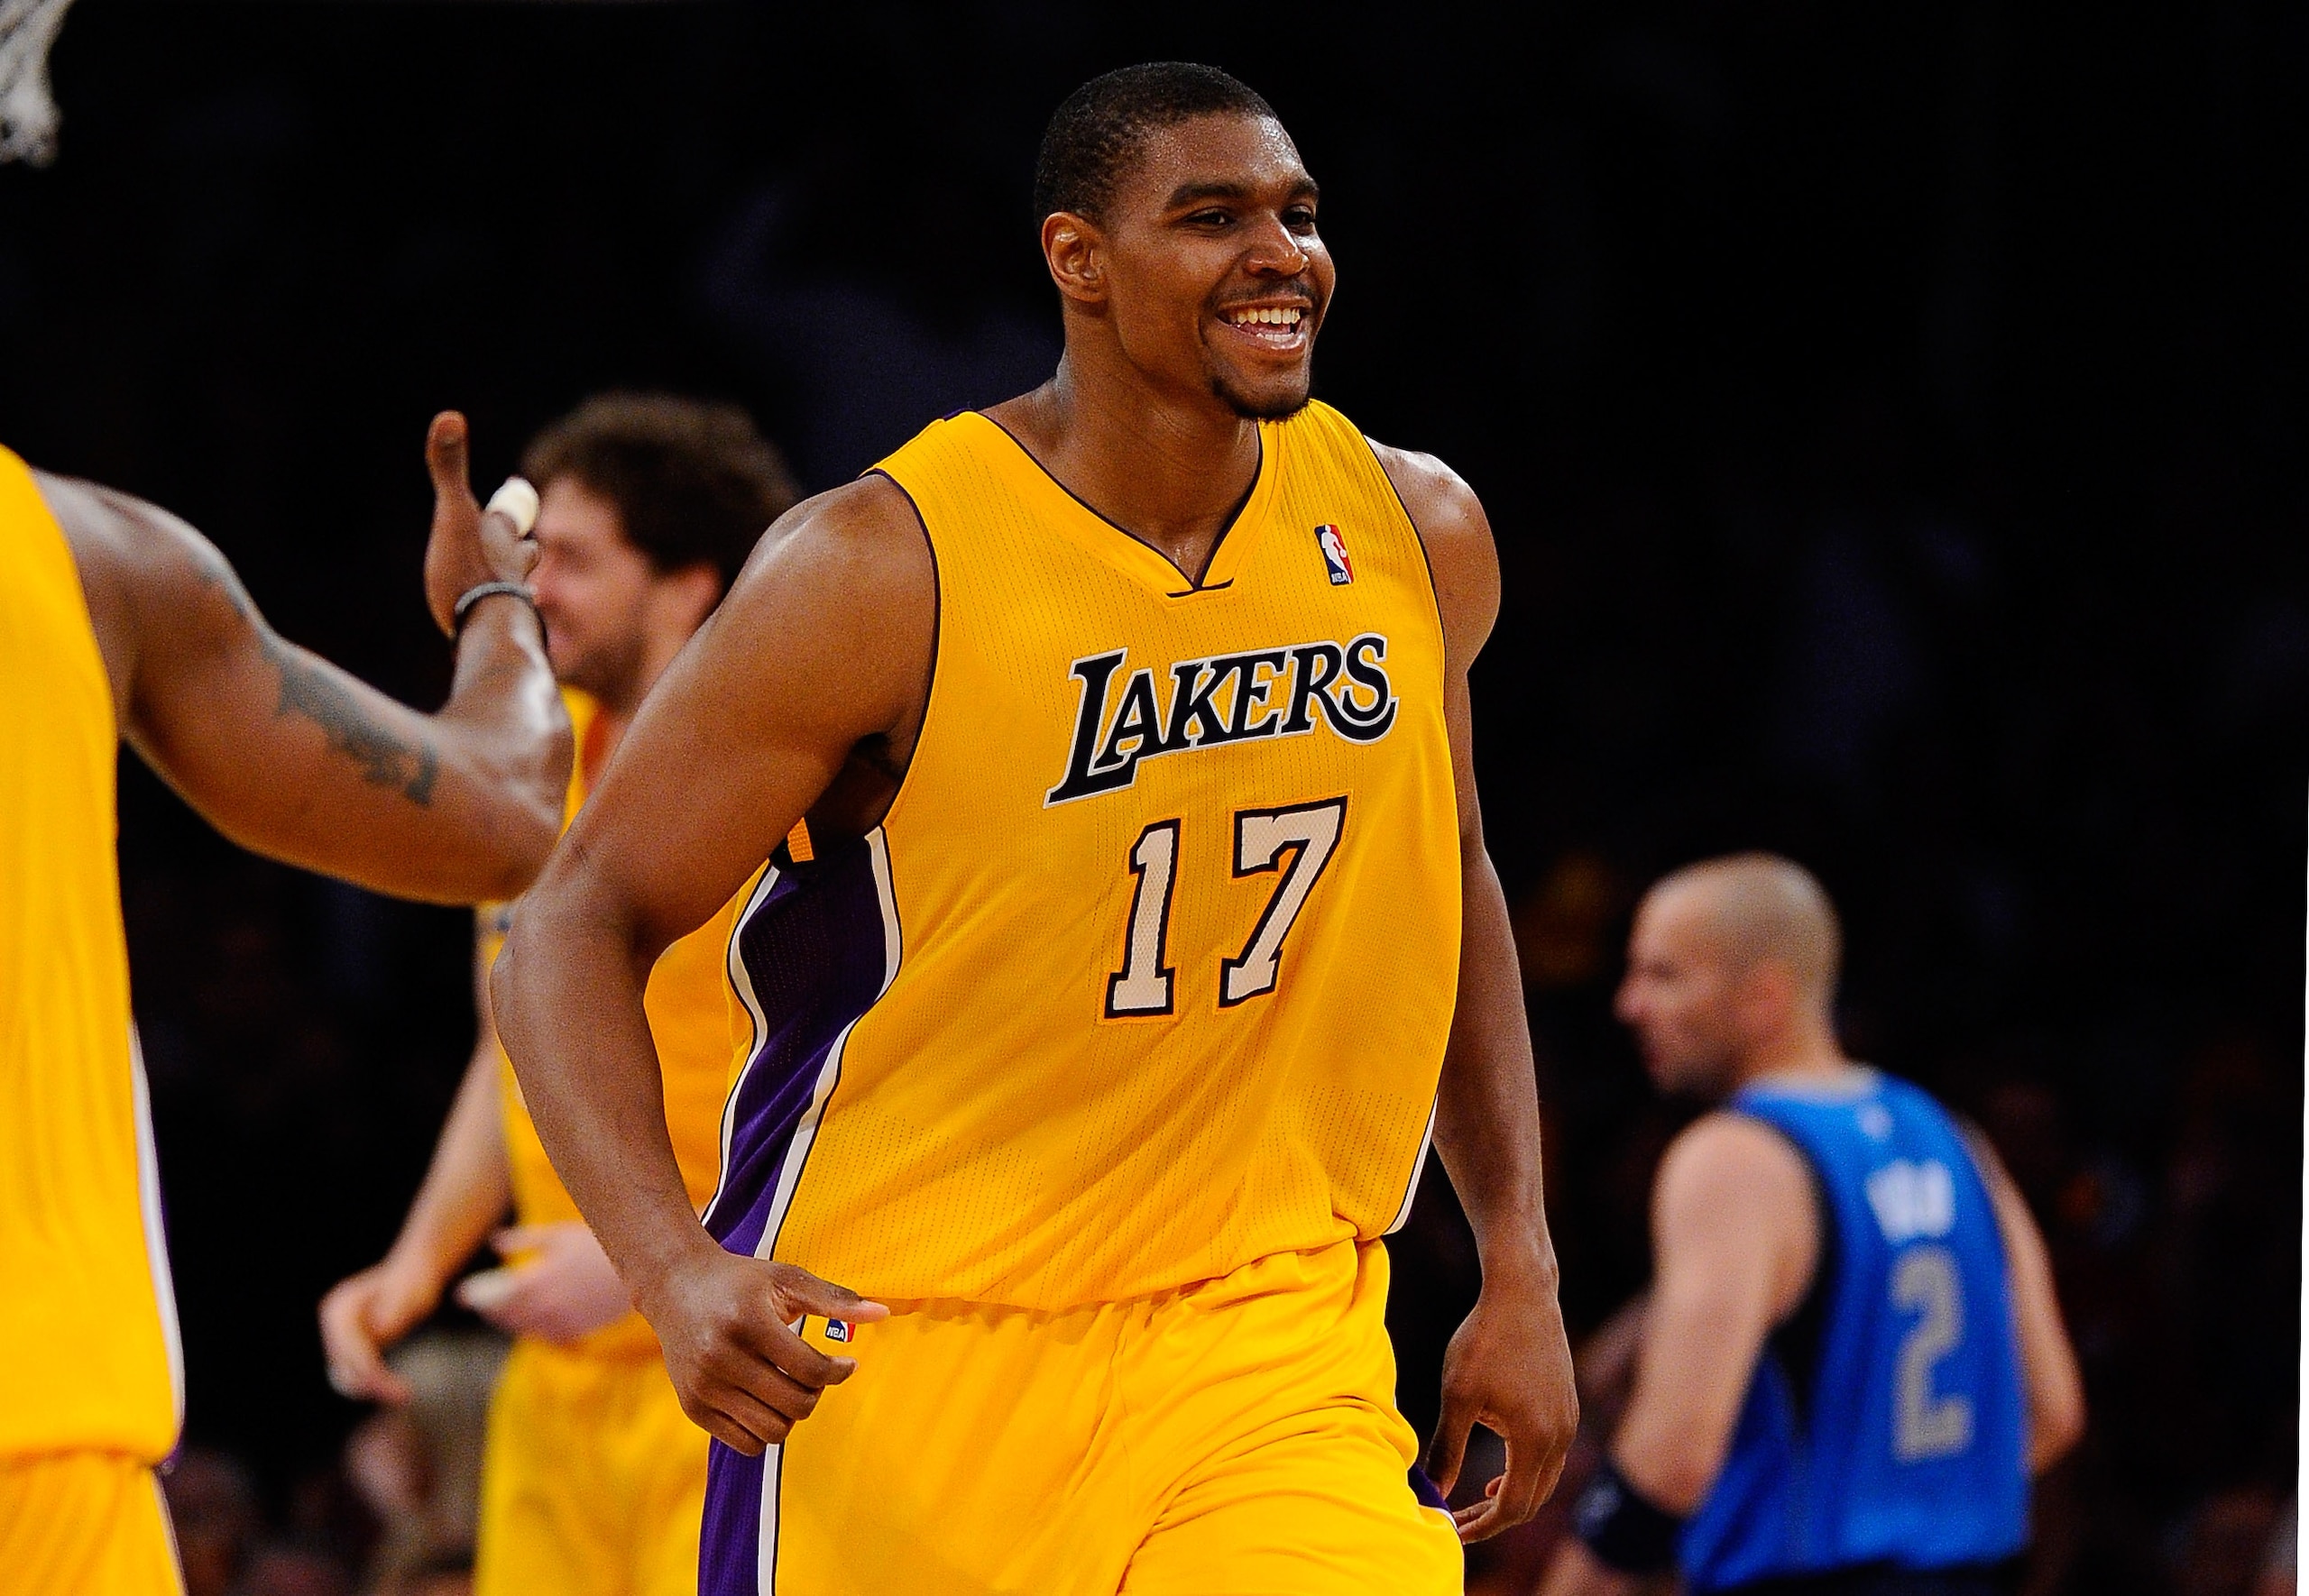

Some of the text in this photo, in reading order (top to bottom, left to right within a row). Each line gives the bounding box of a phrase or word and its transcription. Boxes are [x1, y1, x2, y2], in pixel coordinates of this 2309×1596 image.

[1331, 572, 1348, 582] NBA
[1044, 632, 1398, 808] LAKERS
[1102, 795, 1349, 1020] 17
[826, 1326, 845, 1339] NBA
[1892, 1248, 1973, 1461] 2
